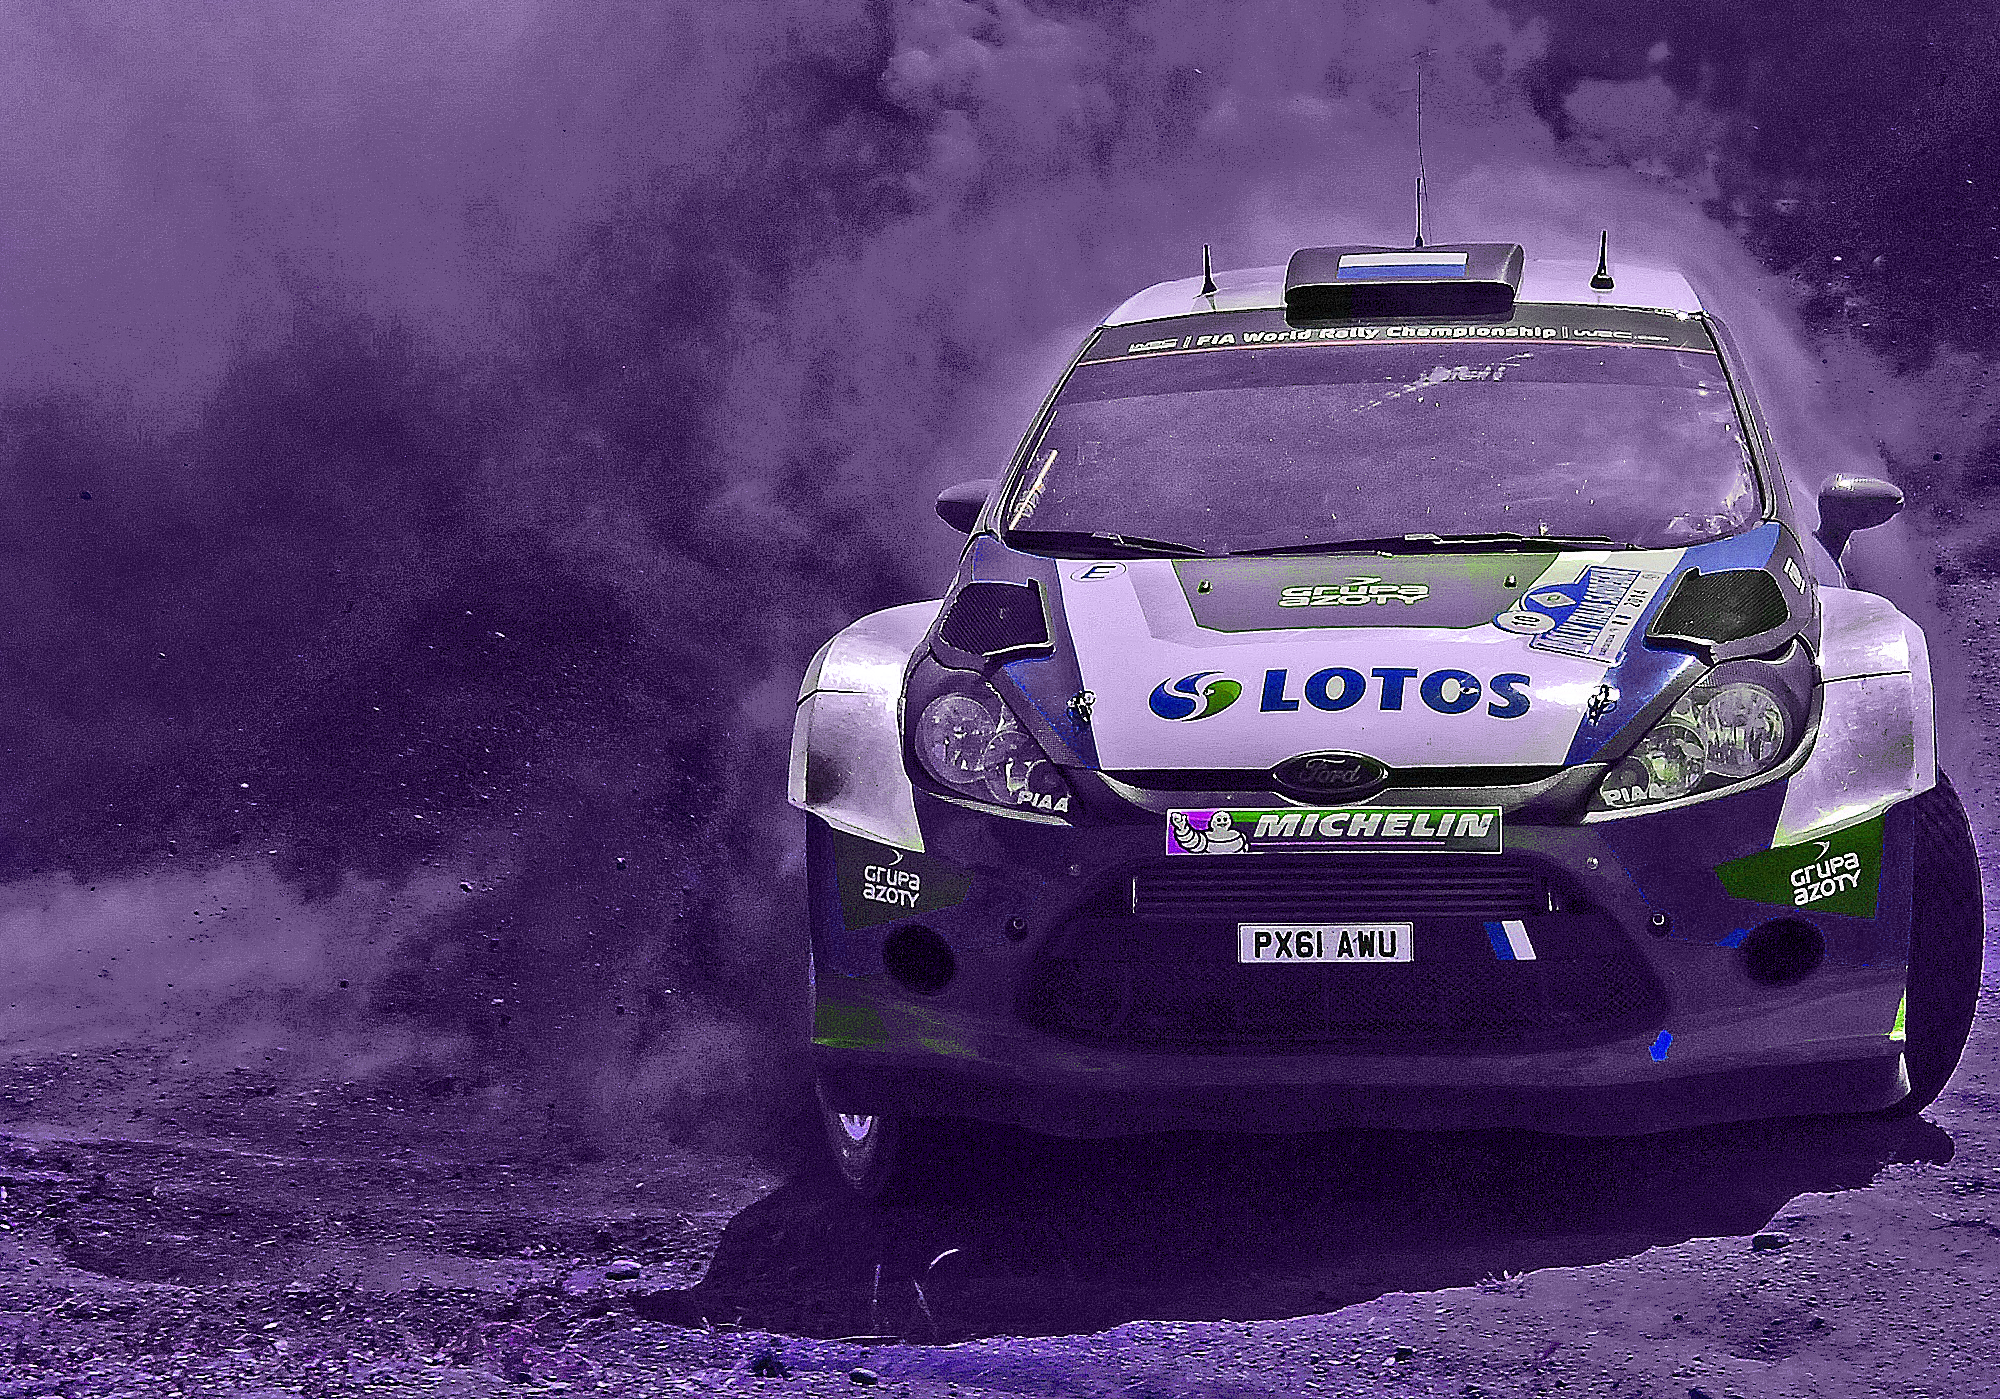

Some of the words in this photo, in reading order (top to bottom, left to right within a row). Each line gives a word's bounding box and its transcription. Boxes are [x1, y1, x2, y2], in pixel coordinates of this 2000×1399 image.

[1196, 333, 1236, 346] FIA
[1243, 328, 1312, 343] World
[1319, 327, 1380, 340] Rally
[1386, 325, 1557, 339] Championship
[1511, 615, 1541, 627] 10
[1259, 666, 1532, 721] LOTOS
[1302, 758, 1361, 784] Ford
[1016, 789, 1069, 813] PIAA
[1253, 813, 1495, 838] MICHELIN
[1254, 931, 1324, 958] PX61
[1337, 931, 1397, 958] AWU
